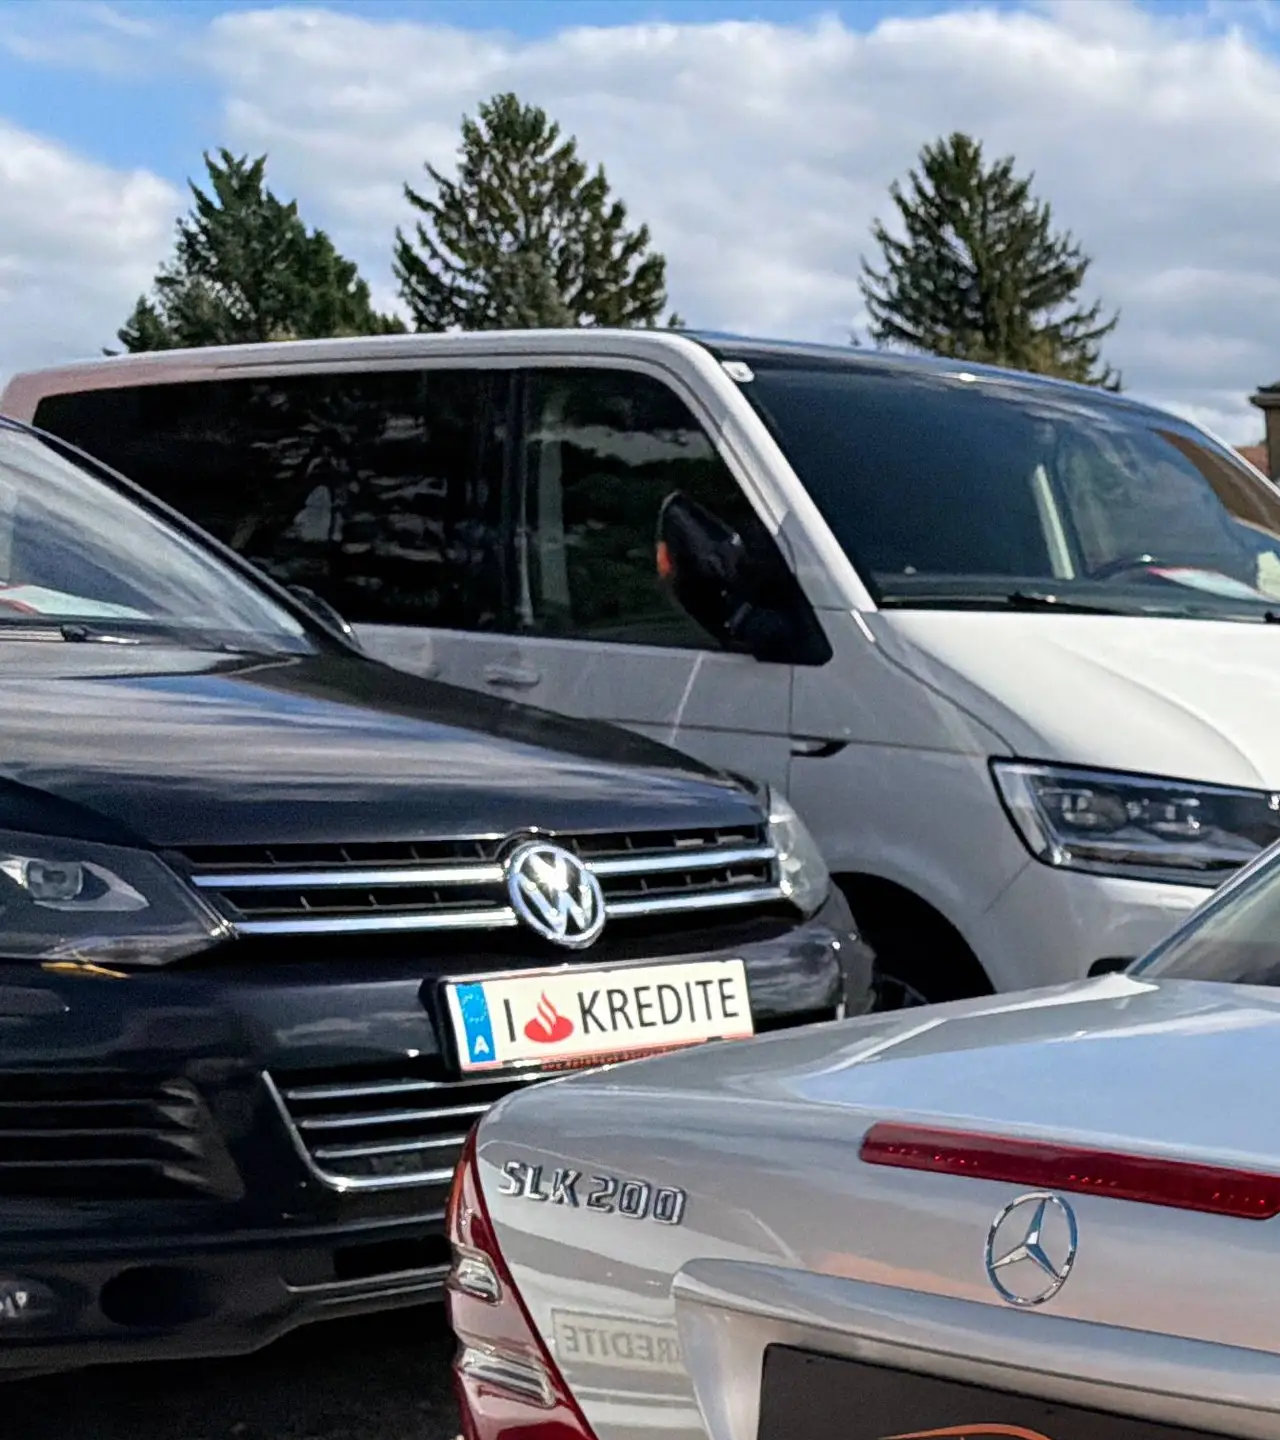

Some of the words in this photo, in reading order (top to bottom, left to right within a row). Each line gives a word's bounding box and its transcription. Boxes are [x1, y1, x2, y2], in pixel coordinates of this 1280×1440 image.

[473, 1034, 491, 1054] A
[578, 978, 739, 1034] KREDITE
[498, 1158, 582, 1208] SLK
[586, 1174, 687, 1225] 200
